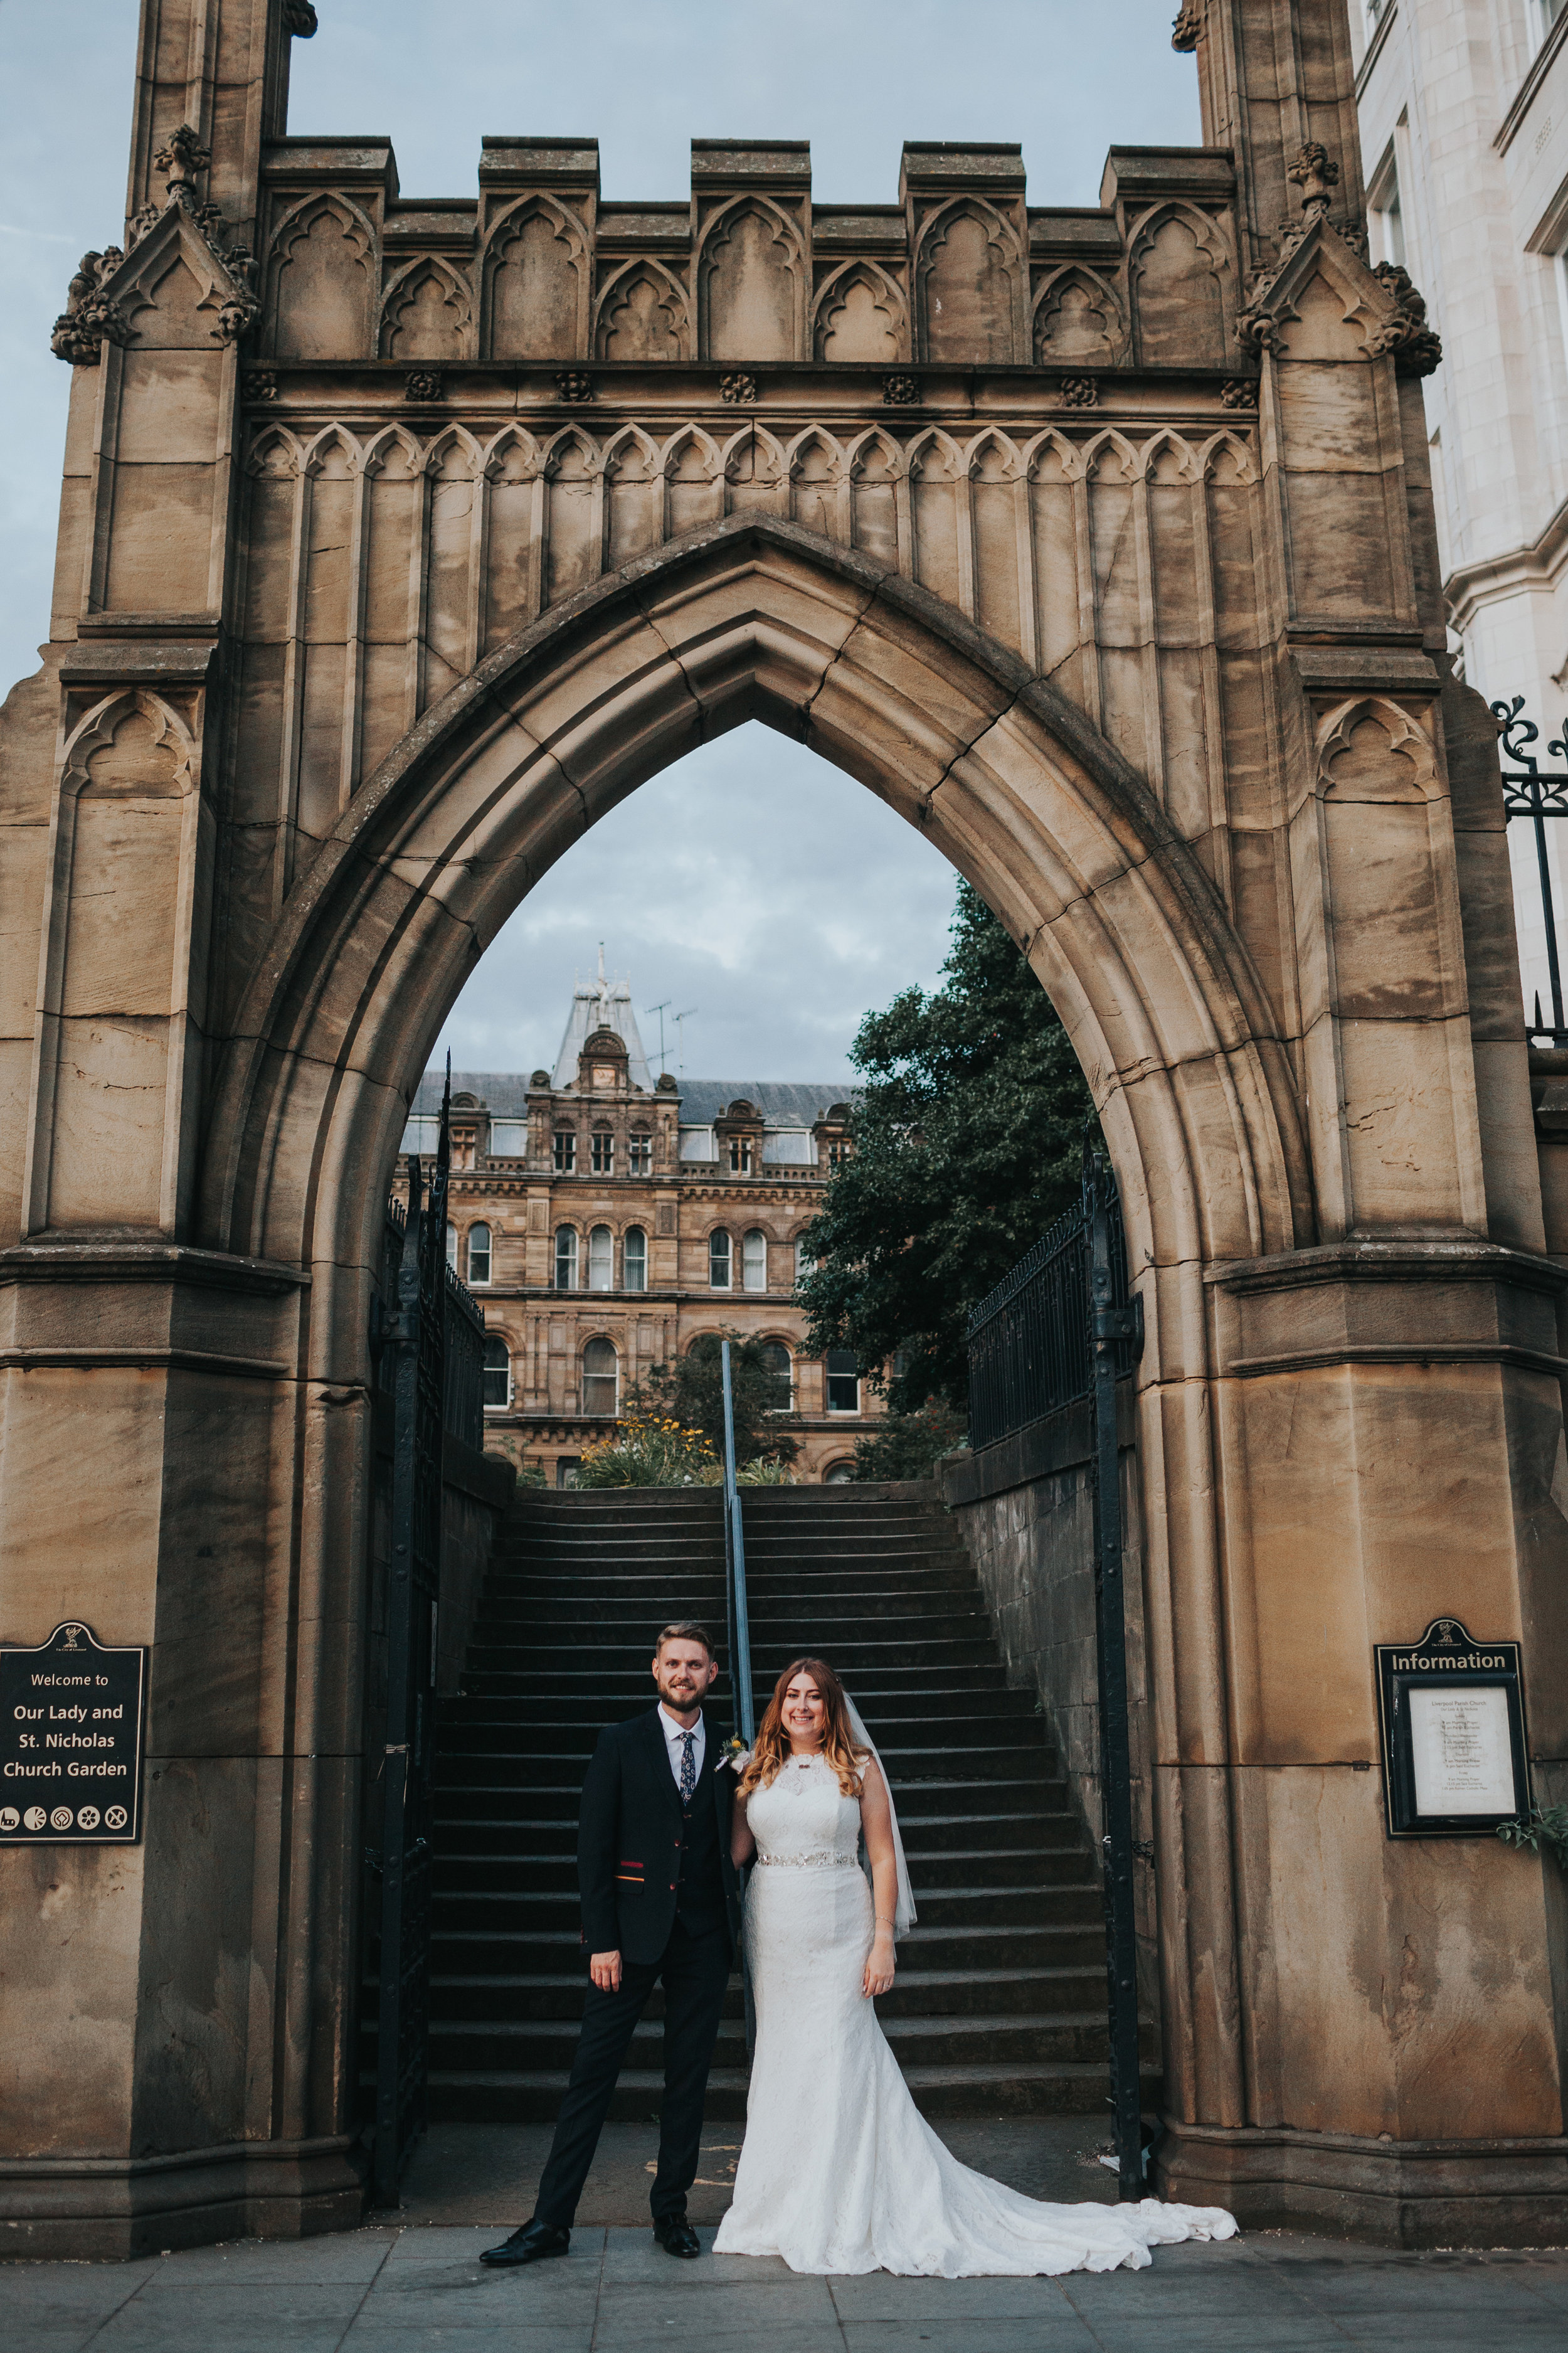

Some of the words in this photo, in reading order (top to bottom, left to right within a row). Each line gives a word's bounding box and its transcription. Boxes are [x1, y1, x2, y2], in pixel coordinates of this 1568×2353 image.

[1393, 1652, 1505, 1669] Information
[32, 1674, 90, 1686] Welcome
[96, 1675, 108, 1686] to
[14, 1706, 44, 1719] Our
[50, 1705, 87, 1723] Lady
[93, 1704, 122, 1718] and
[19, 1734, 39, 1748] St.
[46, 1733, 114, 1747] Nicholas
[4, 1762, 61, 1776] Church
[68, 1761, 126, 1776] Garden
